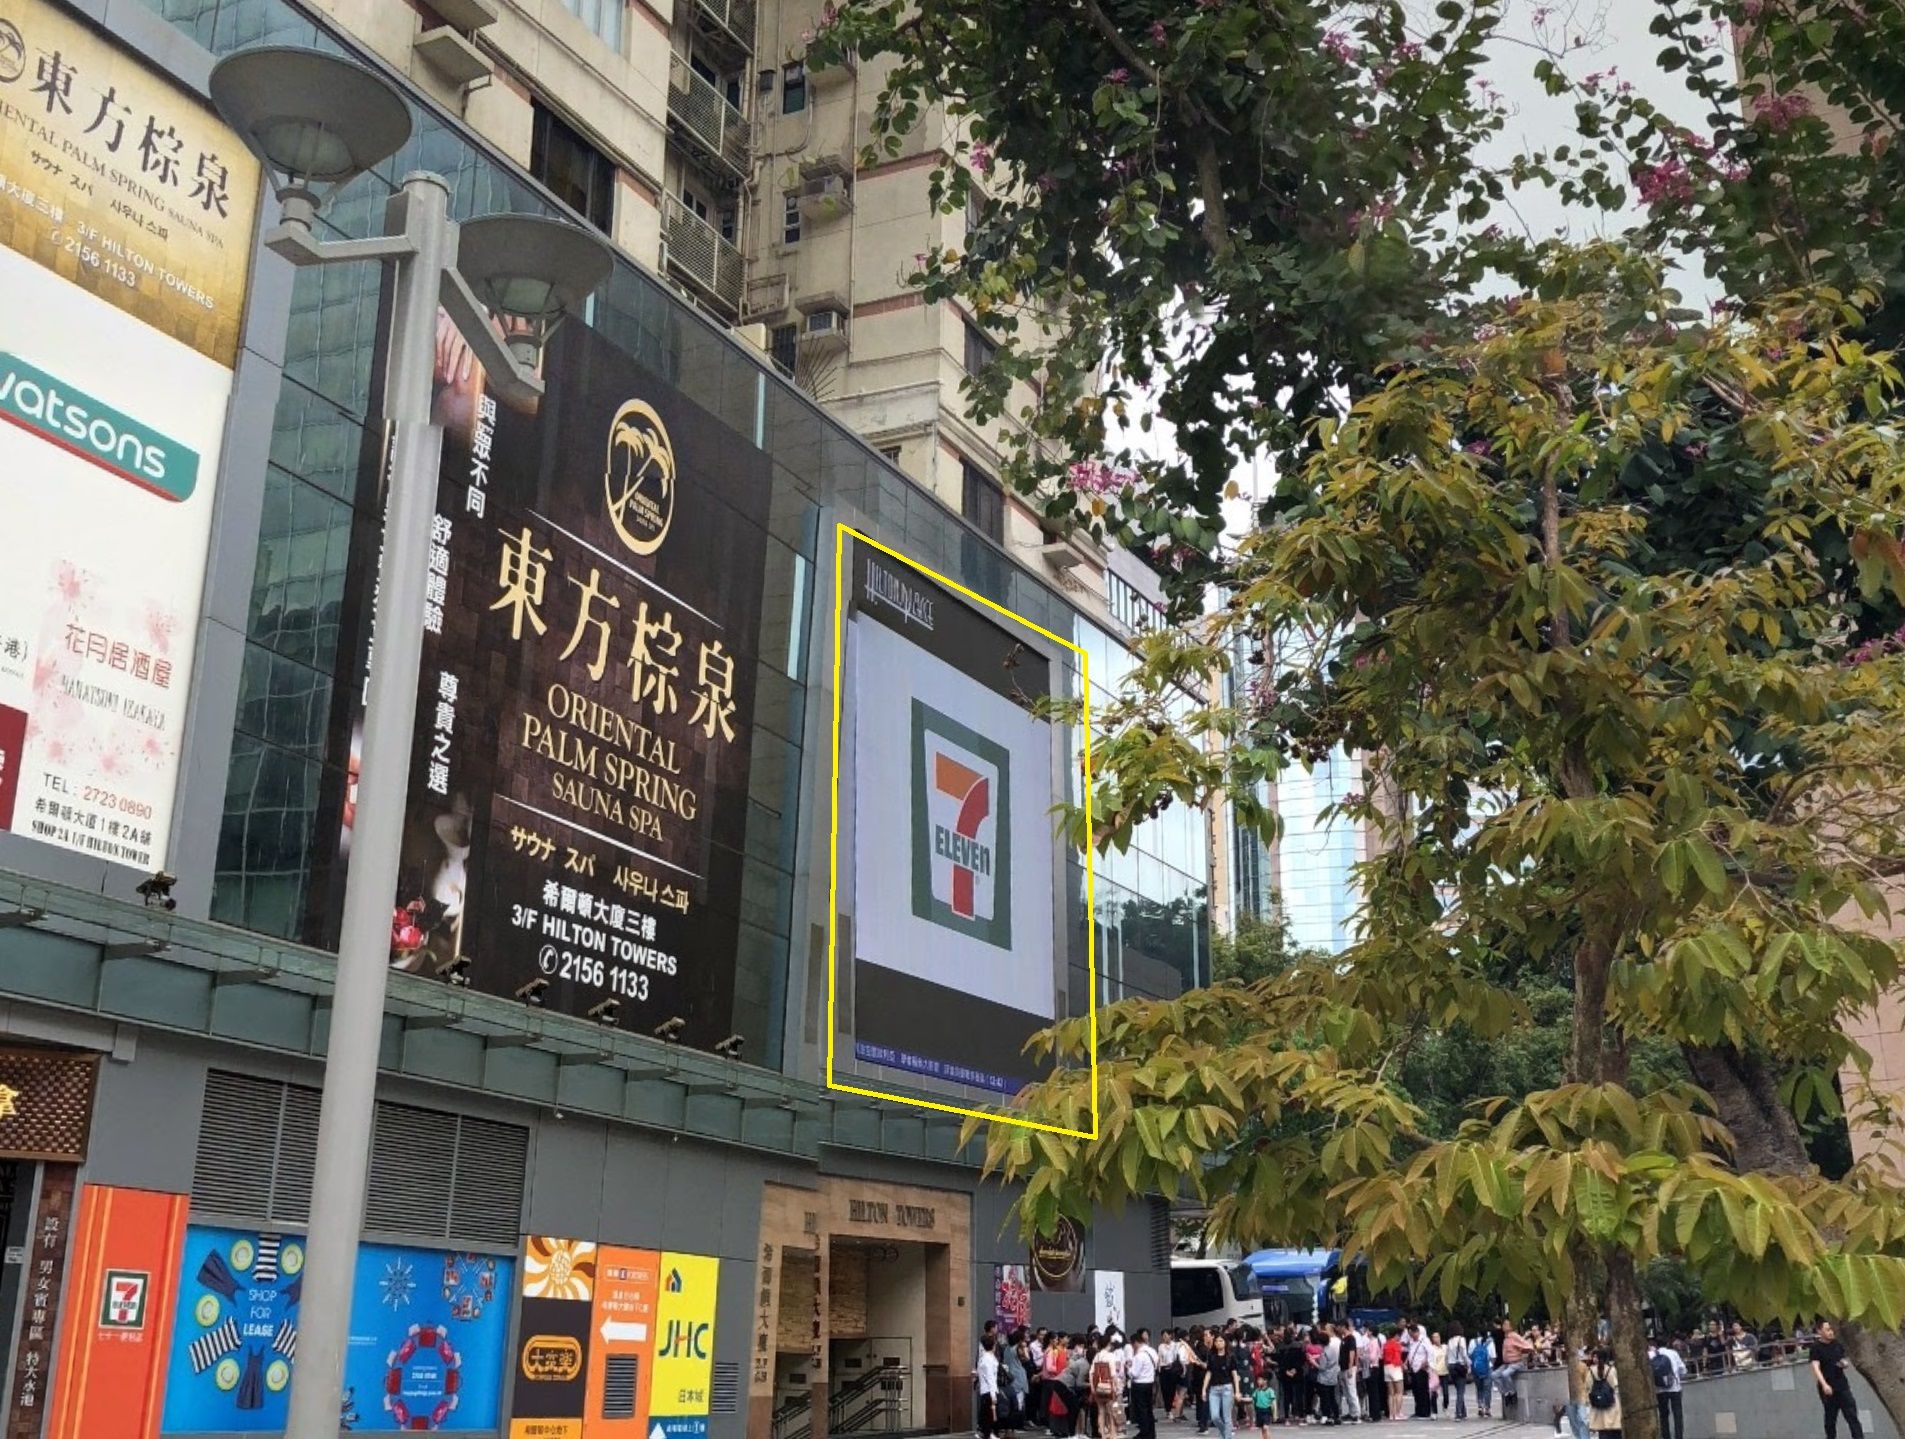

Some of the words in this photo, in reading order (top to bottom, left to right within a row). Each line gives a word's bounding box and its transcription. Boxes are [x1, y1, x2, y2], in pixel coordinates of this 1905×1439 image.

[30, 51, 230, 219] 東方棕泉
[31, 150, 63, 175] サウナ
[62, 138, 105, 176] PALM
[110, 169, 165, 212] SPRING
[167, 208, 203, 237] SAUNA
[110, 199, 144, 228] 사우나
[64, 236, 100, 268] 2156
[104, 259, 136, 287] 1133
[101, 236, 154, 275] HILTON
[159, 268, 214, 309] TOWERS
[65, 623, 173, 690] 花月居酒屋
[489, 527, 737, 743] 東方棕泉
[427, 671, 460, 796] 尊貴之選
[548, 683, 682, 775] ORIENTAL
[521, 711, 600, 780] PALM
[604, 752, 697, 821] SPRING
[83, 785, 117, 809] 2723
[119, 797, 153, 820] 0890
[552, 771, 624, 826] SAUNA
[628, 805, 664, 842] SPA
[31, 820, 57, 838] SHOP
[510, 825, 557, 863] サウナ
[563, 846, 597, 877] スパ
[542, 878, 657, 943] 希爾頓大廈三樓
[612, 864, 658, 904] 사우나
[659, 883, 690, 915] 스파
[511, 903, 538, 931] 3/F
[542, 915, 607, 953] HILTON
[610, 935, 678, 976] TOWERS
[559, 950, 605, 988] 2156
[609, 965, 650, 1001] 1133
[848, 1199, 889, 1225] HILTON
[896, 1204, 936, 1230] TOWERS
[249, 1289, 277, 1302] SHOP
[250, 1305, 272, 1319] FOR
[243, 1323, 274, 1337] LEASE
[658, 1319, 709, 1360] JHC
[678, 1389, 704, 1403] 日本城
